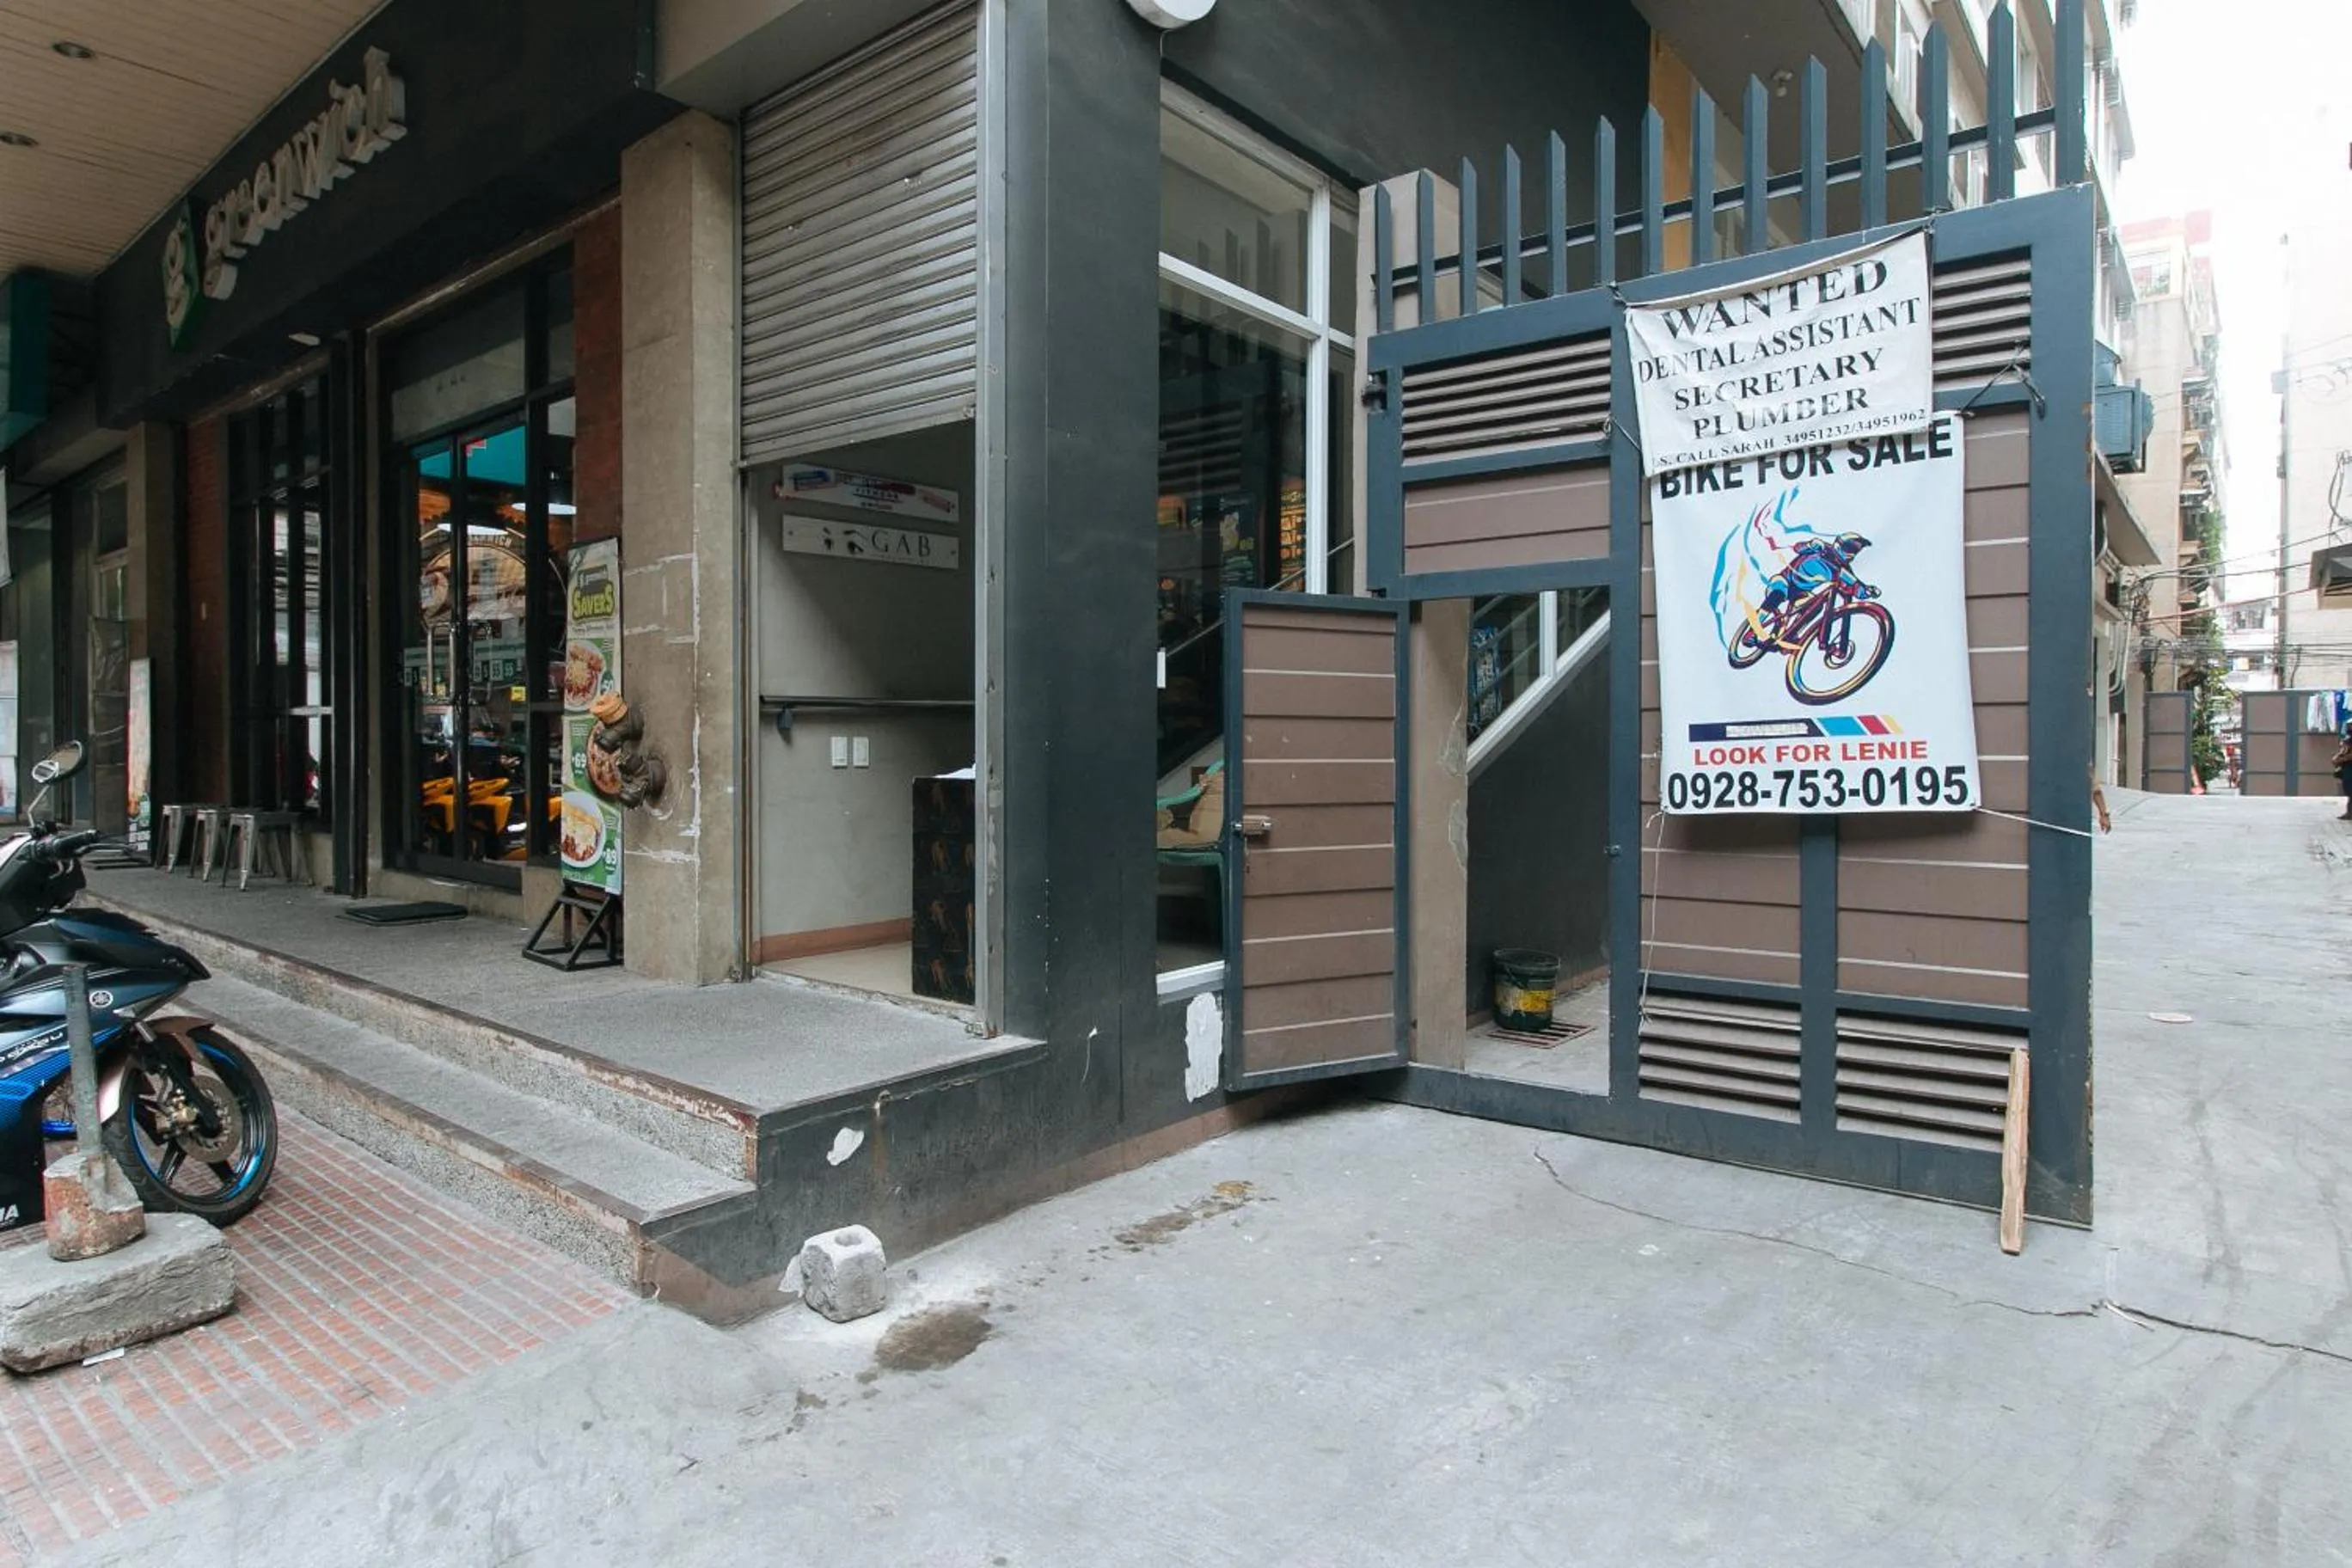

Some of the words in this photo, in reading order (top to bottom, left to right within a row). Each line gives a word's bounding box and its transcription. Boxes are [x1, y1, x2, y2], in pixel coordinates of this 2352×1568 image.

[1660, 260, 1888, 340] WANTED
[1638, 342, 1744, 383] DENTAL
[1752, 297, 1921, 361] ASSISTANT
[1675, 347, 1883, 411] SECRETARY
[1676, 448, 1718, 464] CALL
[1720, 438, 1775, 456] SARAH
[1782, 408, 1926, 447] 34951232/34951962
[1693, 388, 1871, 440] PLUMBER
[1659, 460, 1744, 499] BIKE
[1757, 441, 1835, 486] FOR
[1847, 418, 1954, 471] SALE
[871, 530, 932, 558] GAB
[1694, 745, 1767, 767] LOOK
[1775, 744, 1832, 763] FOR
[1841, 741, 1928, 762] LENIE
[1667, 765, 1969, 810] 0928-753-0195
